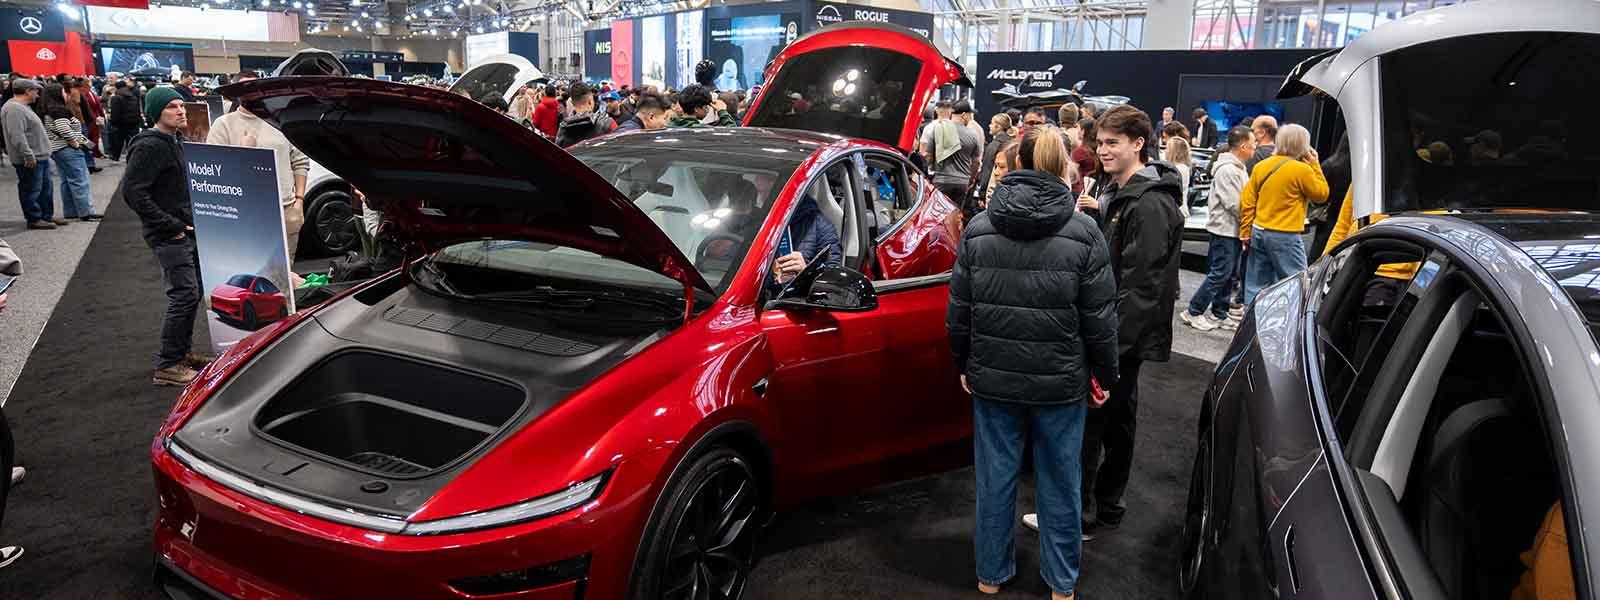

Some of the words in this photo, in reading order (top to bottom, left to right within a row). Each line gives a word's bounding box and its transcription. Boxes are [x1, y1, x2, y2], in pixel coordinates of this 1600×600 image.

[855, 10, 889, 23] ROGUE
[987, 69, 1053, 80] McLaren
[188, 162, 214, 176] Model
[214, 164, 221, 177] Y
[191, 179, 243, 196] Performance
